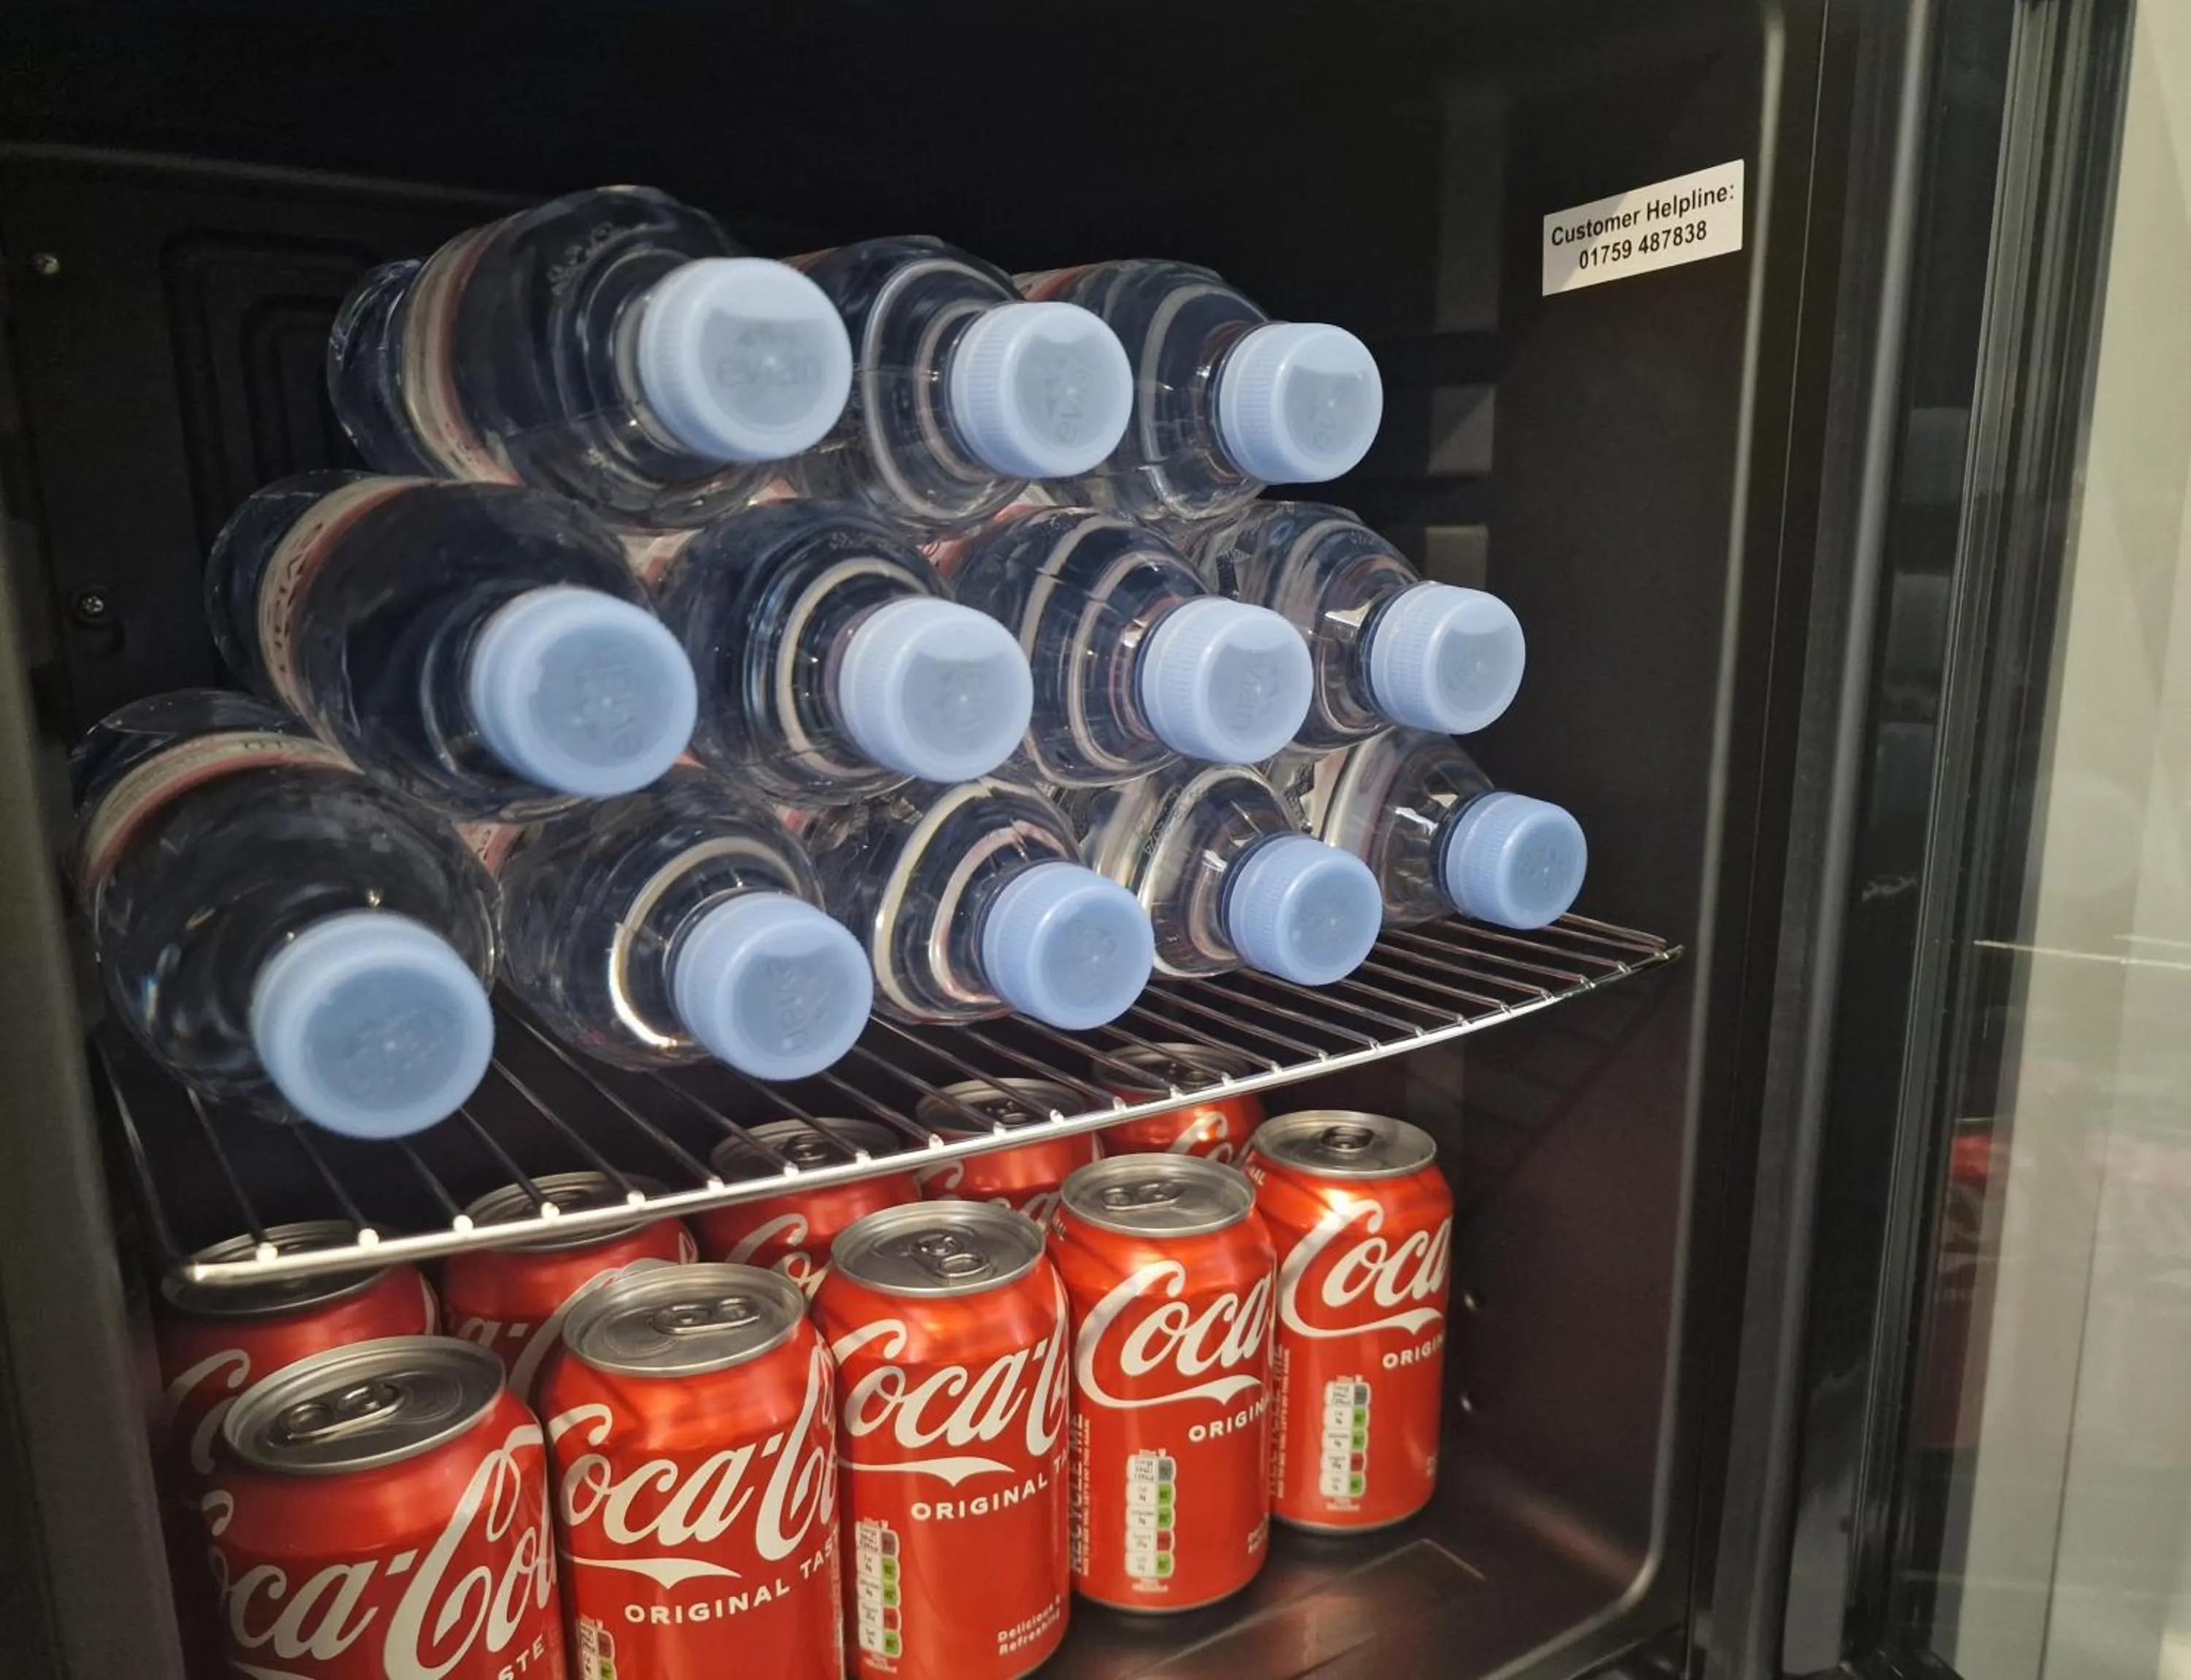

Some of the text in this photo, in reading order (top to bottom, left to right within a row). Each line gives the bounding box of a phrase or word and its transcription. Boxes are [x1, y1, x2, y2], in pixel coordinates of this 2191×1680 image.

[1551, 183, 1735, 246] Customer Helpline:
[1579, 220, 1707, 270] 01759 487838
[911, 1472, 1048, 1521] ORIGINAL
[624, 1524, 838, 1625] ORIGINAL TAS
